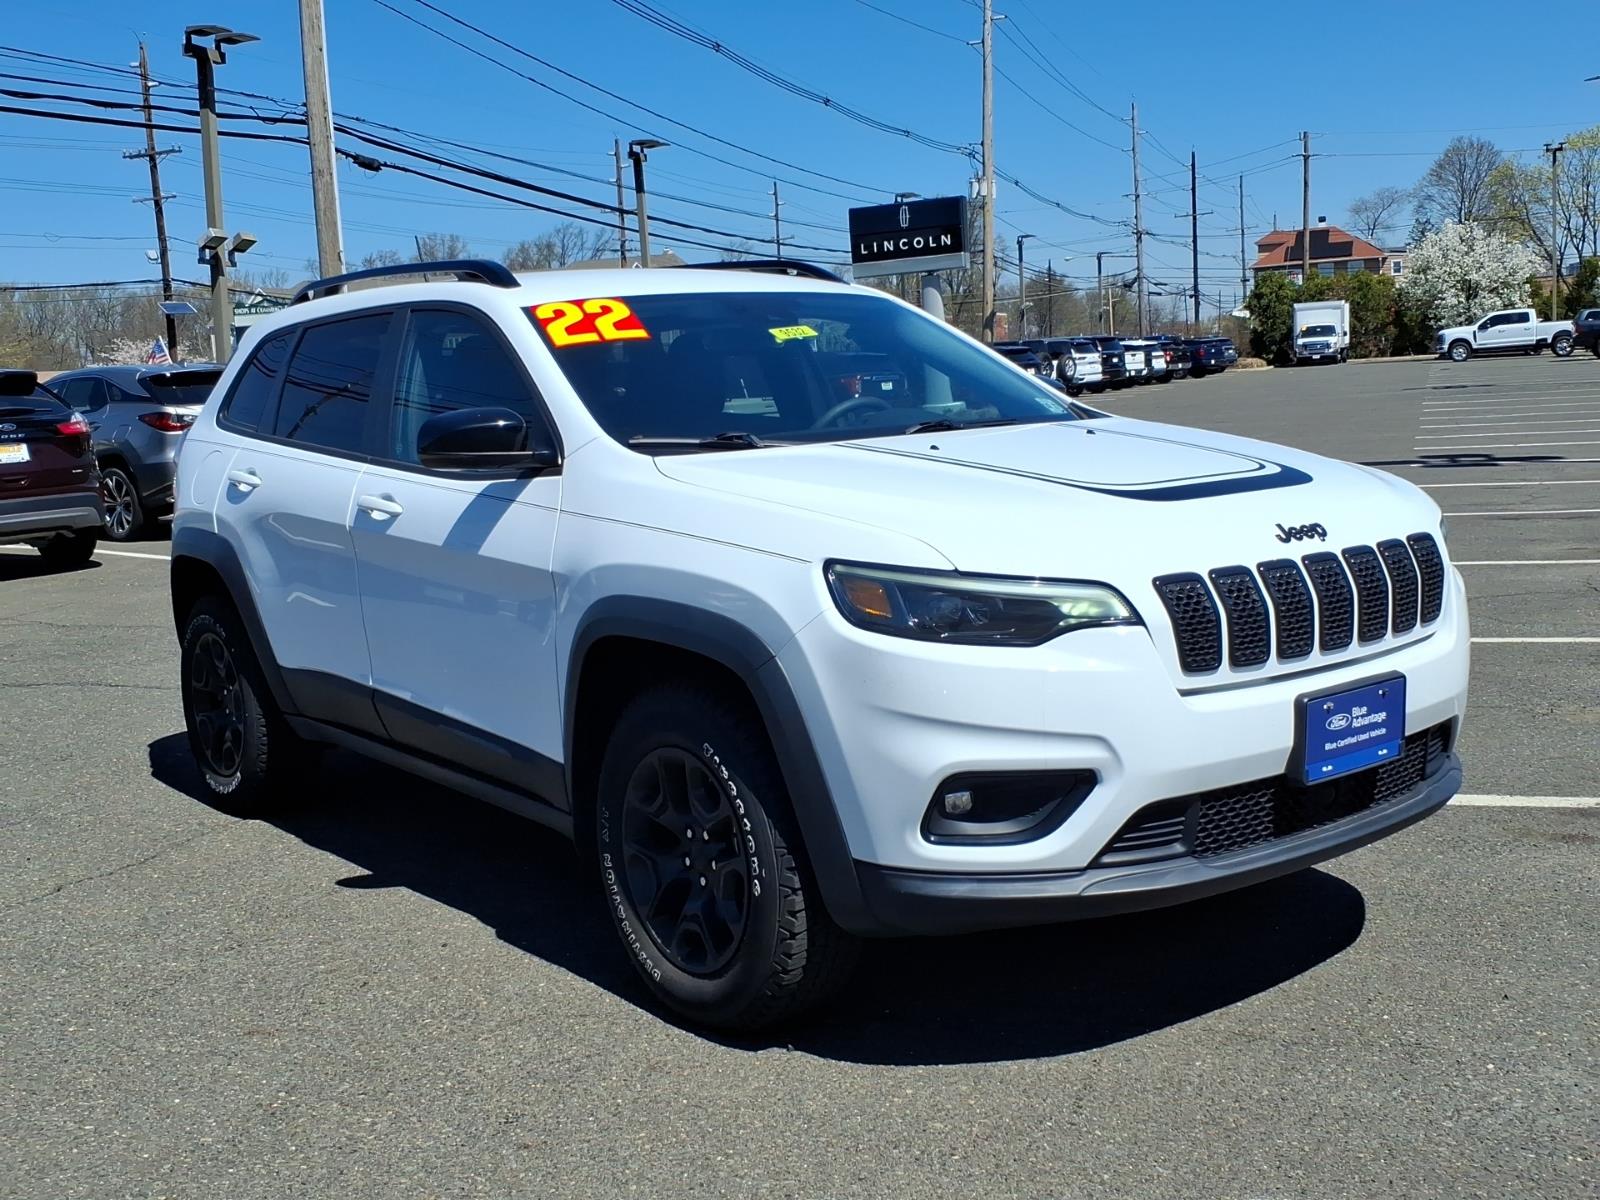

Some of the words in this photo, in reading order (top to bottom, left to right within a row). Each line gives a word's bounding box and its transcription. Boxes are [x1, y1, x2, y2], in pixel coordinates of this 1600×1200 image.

[860, 234, 952, 255] LINCOLN
[535, 298, 650, 347] 22
[1275, 522, 1328, 544] Jeep
[1351, 711, 1387, 728] Advantage
[1352, 706, 1367, 717] Blue
[1324, 742, 1337, 751] Blue
[1370, 728, 1387, 738] Vehicle
